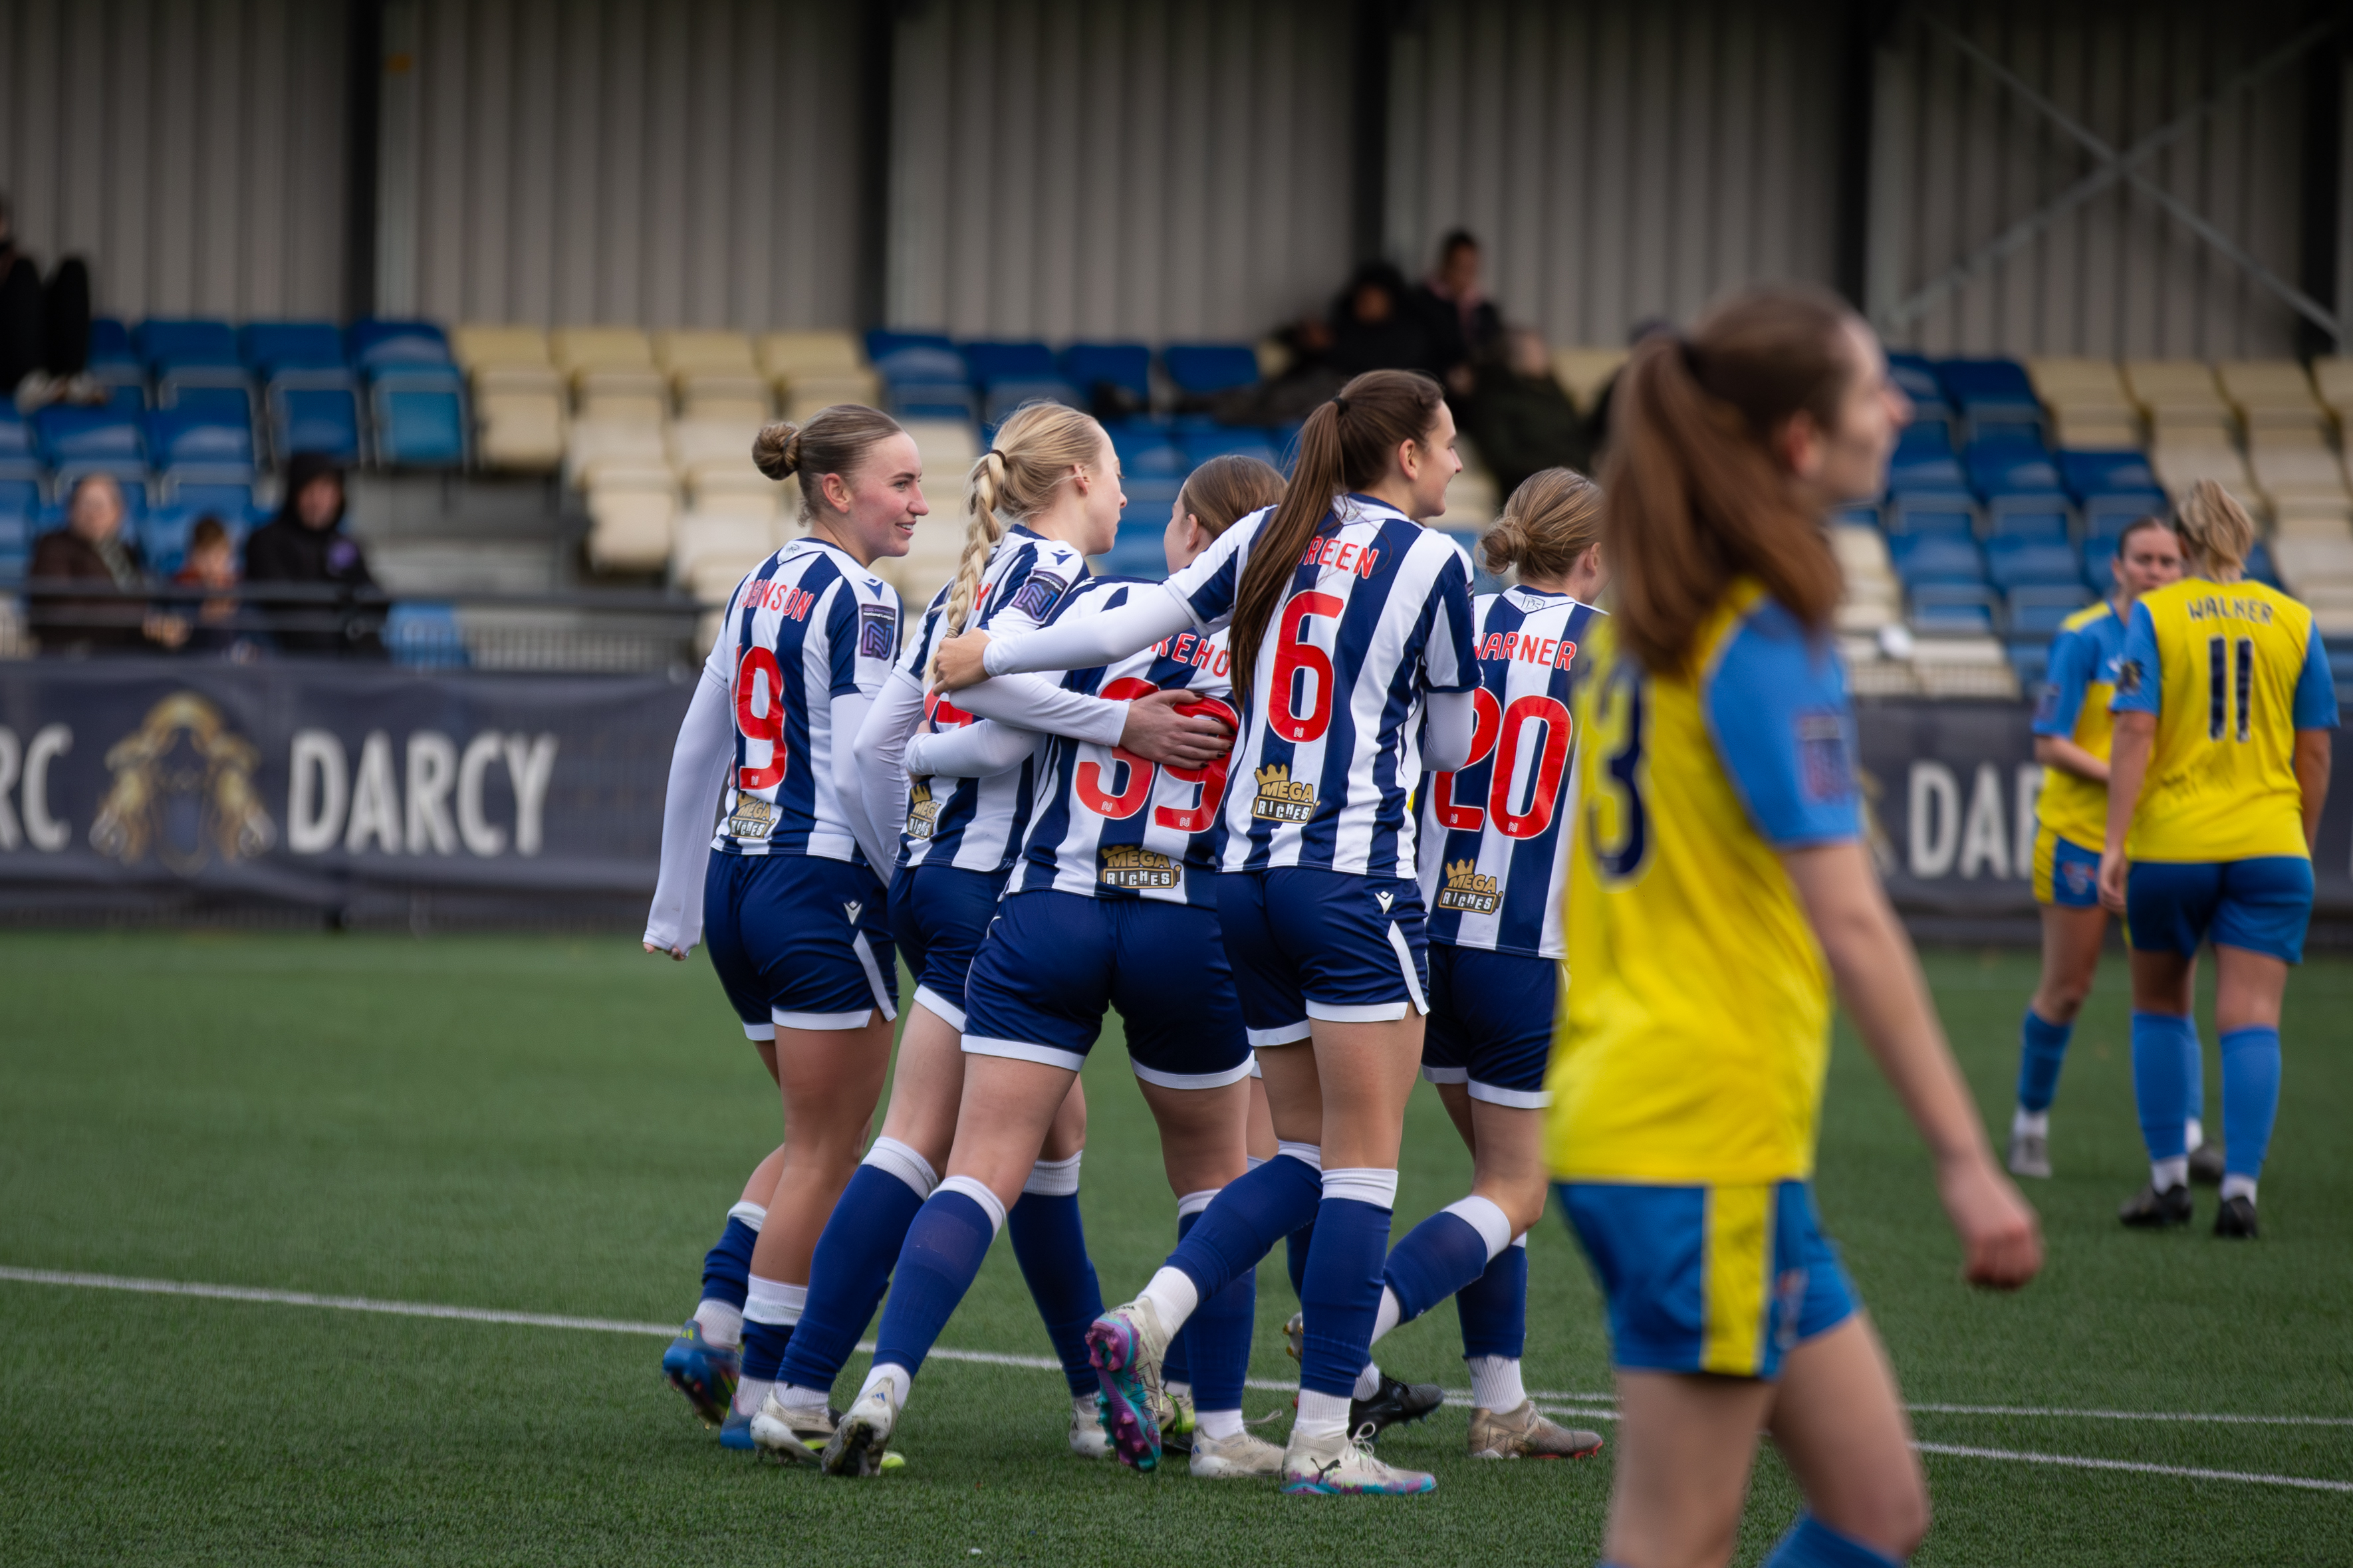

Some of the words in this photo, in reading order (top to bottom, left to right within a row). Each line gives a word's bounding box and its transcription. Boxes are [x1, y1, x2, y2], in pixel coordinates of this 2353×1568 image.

[1297, 536, 1380, 580] REEN
[2187, 595, 2275, 626] WALKER
[1267, 589, 1344, 744] 6
[2207, 632, 2255, 744] 11
[729, 643, 788, 791] 9
[1075, 676, 1239, 834] 39
[1434, 685, 1573, 840] 20
[287, 728, 558, 857] DARCY
[1261, 780, 1314, 803] MEGA
[736, 802, 771, 821] MEGA
[1257, 800, 1310, 820] RICHES
[731, 820, 765, 836] RICHES
[1107, 851, 1171, 868] MEGA
[1106, 870, 1170, 886] RICHES
[1447, 873, 1497, 894] MEGA
[1441, 891, 1493, 910] RICHES
